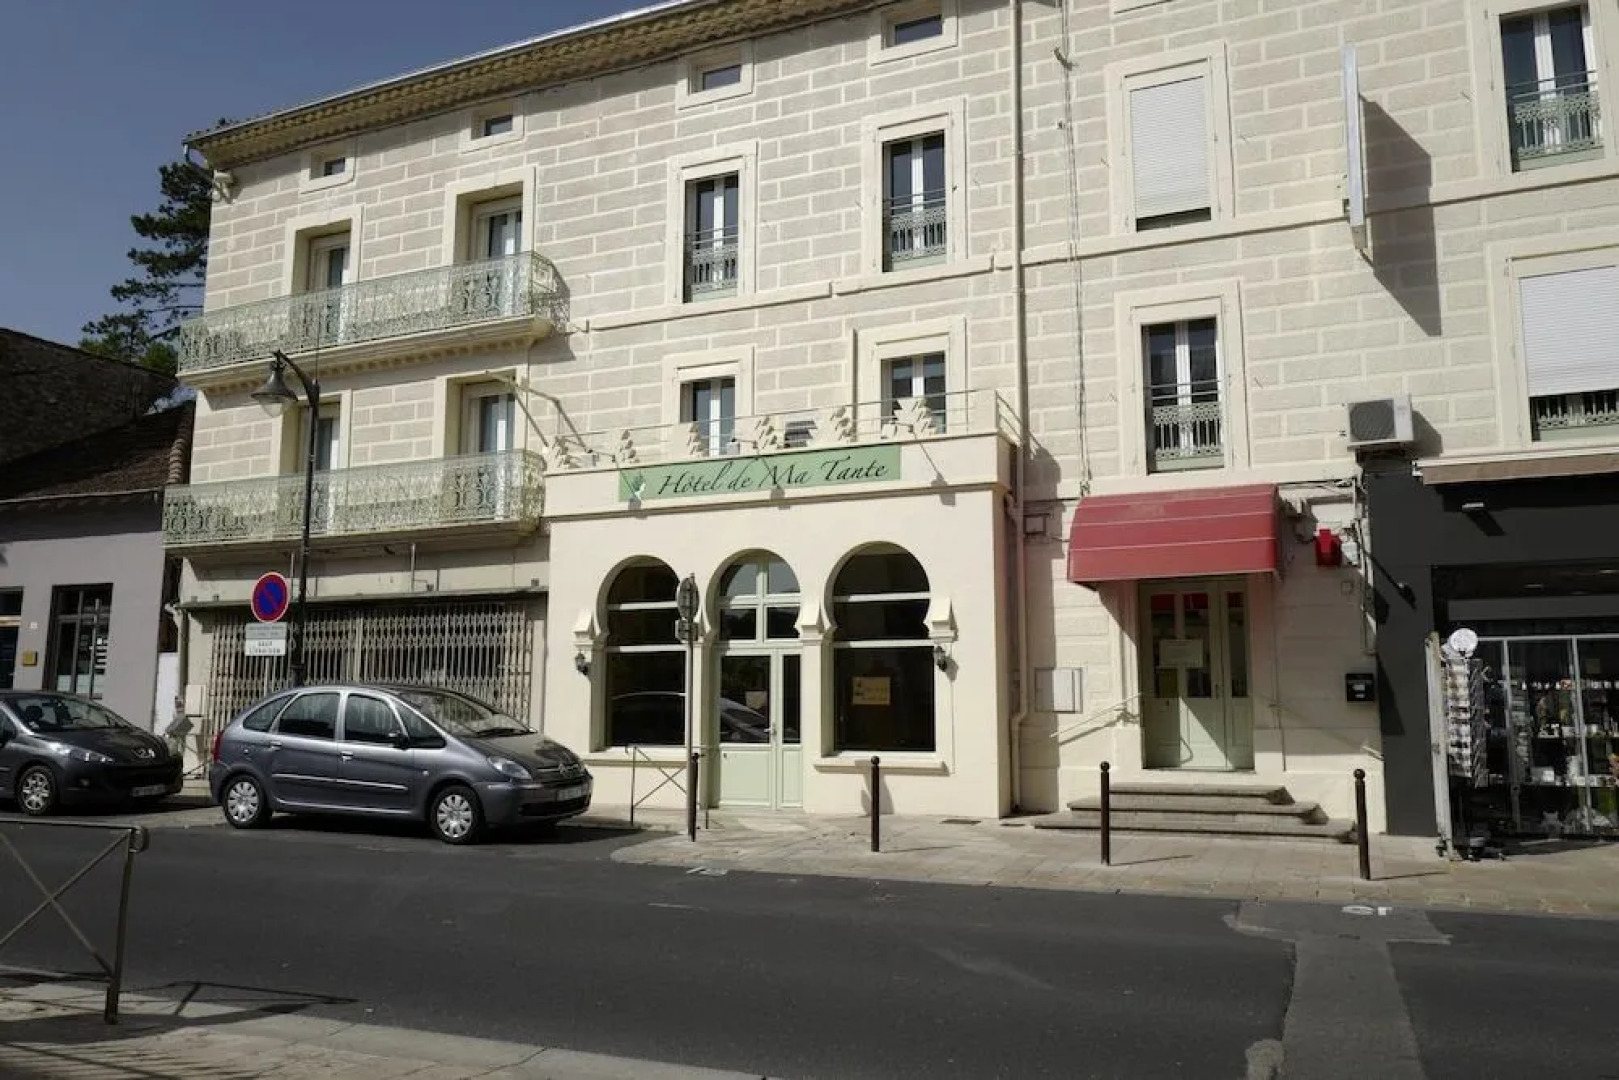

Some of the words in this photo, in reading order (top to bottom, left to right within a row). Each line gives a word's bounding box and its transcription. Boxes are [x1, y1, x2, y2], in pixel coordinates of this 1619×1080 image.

[657, 462, 730, 495] Hôtel
[728, 459, 755, 490] de
[759, 463, 811, 487] Ma
[821, 456, 888, 481] Tante
